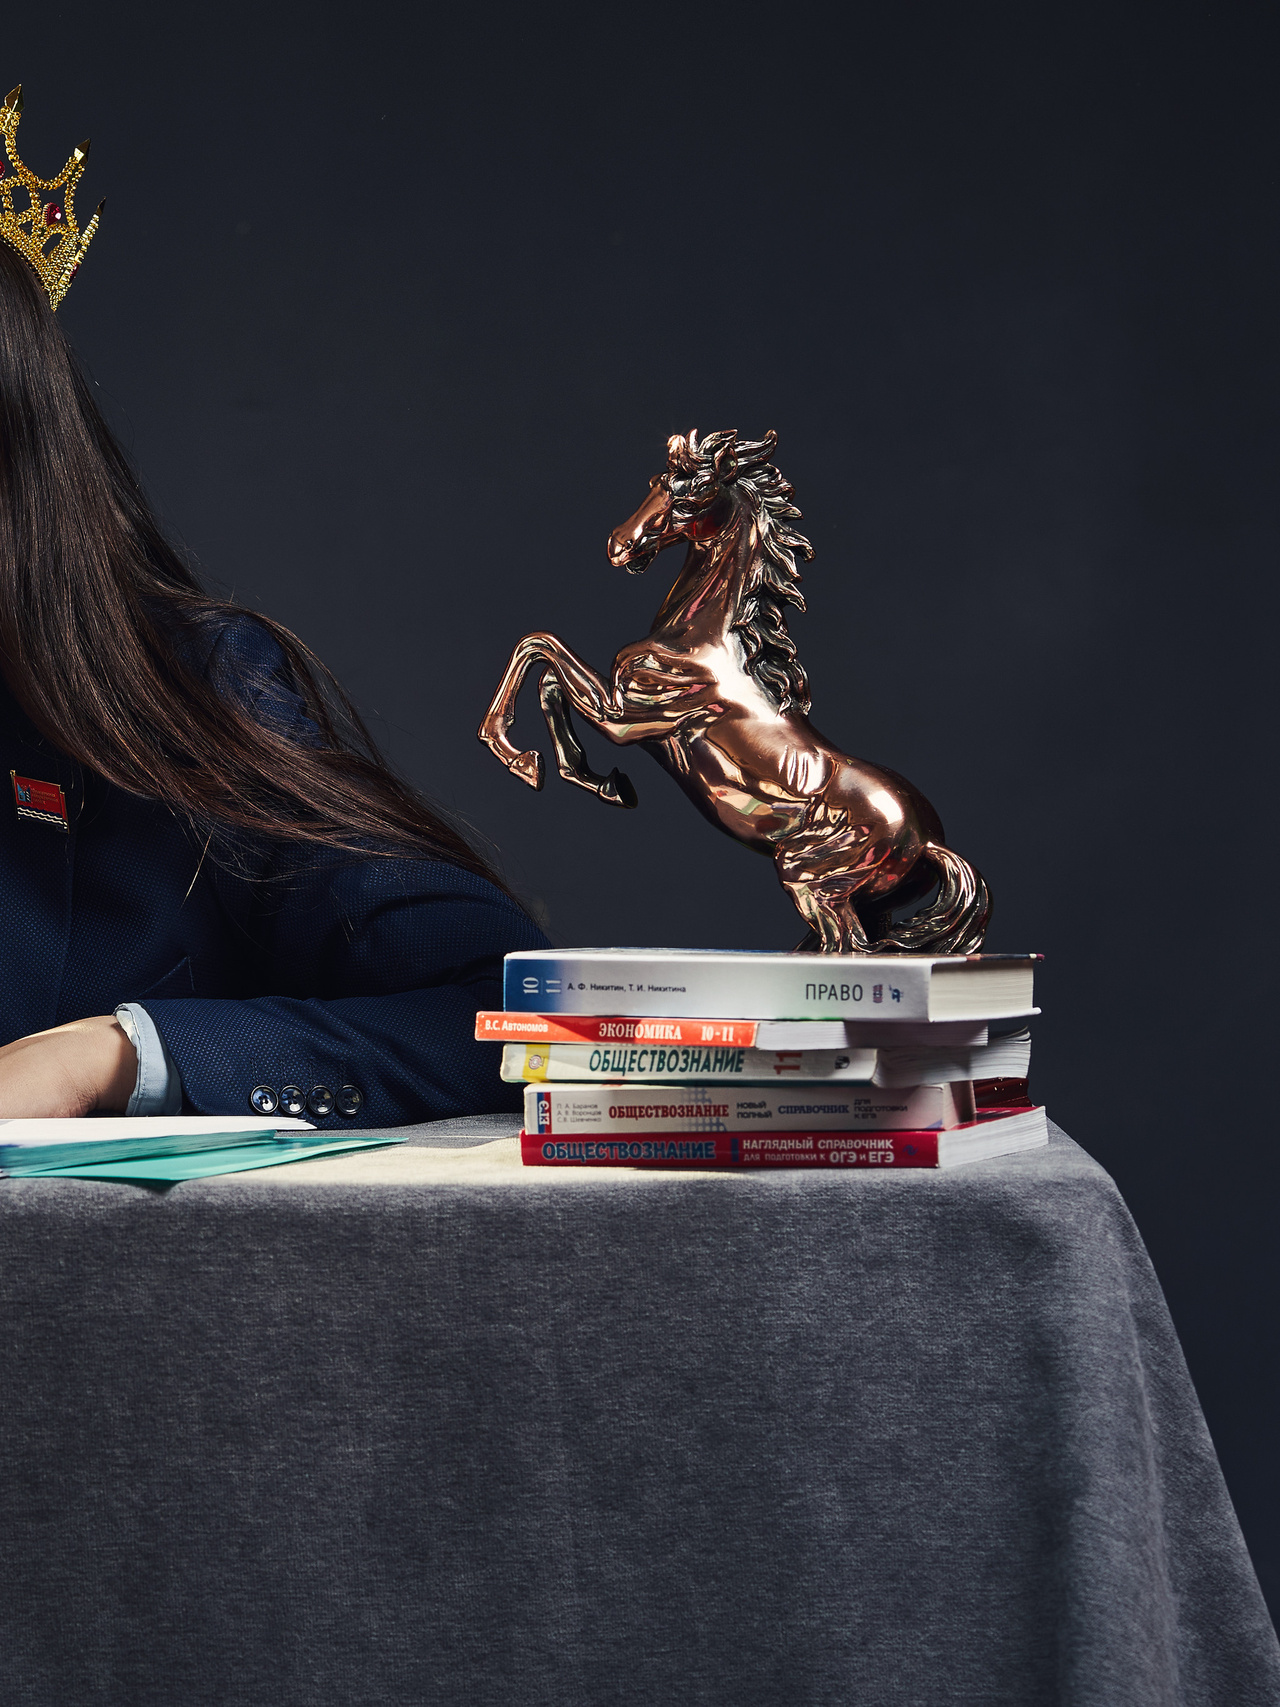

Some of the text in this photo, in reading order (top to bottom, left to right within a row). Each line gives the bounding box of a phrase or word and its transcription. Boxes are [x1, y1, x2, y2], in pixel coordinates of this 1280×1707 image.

[523, 977, 539, 994] 10
[546, 979, 561, 993] 11
[805, 983, 863, 1001] ПРАВО
[599, 1022, 682, 1040] ЭКОНОМИКА
[589, 1049, 745, 1076] ОБЩЕСТВОЗНАНИЕ
[773, 1052, 802, 1075] 11
[538, 1100, 550, 1126] ЕГЭ
[609, 1105, 729, 1120] ОБЩЕСТВОЗНАНИЕ
[778, 1104, 849, 1114] СПРАВОЧНИК
[542, 1141, 716, 1163] ОБЩЕСТВОЗНАНИЕ
[743, 1137, 894, 1150] НАГЛЯДНЫЙ СПРАВОЧНИК
[829, 1151, 857, 1163] ОГЭ
[869, 1151, 895, 1163] ЕГЭ
